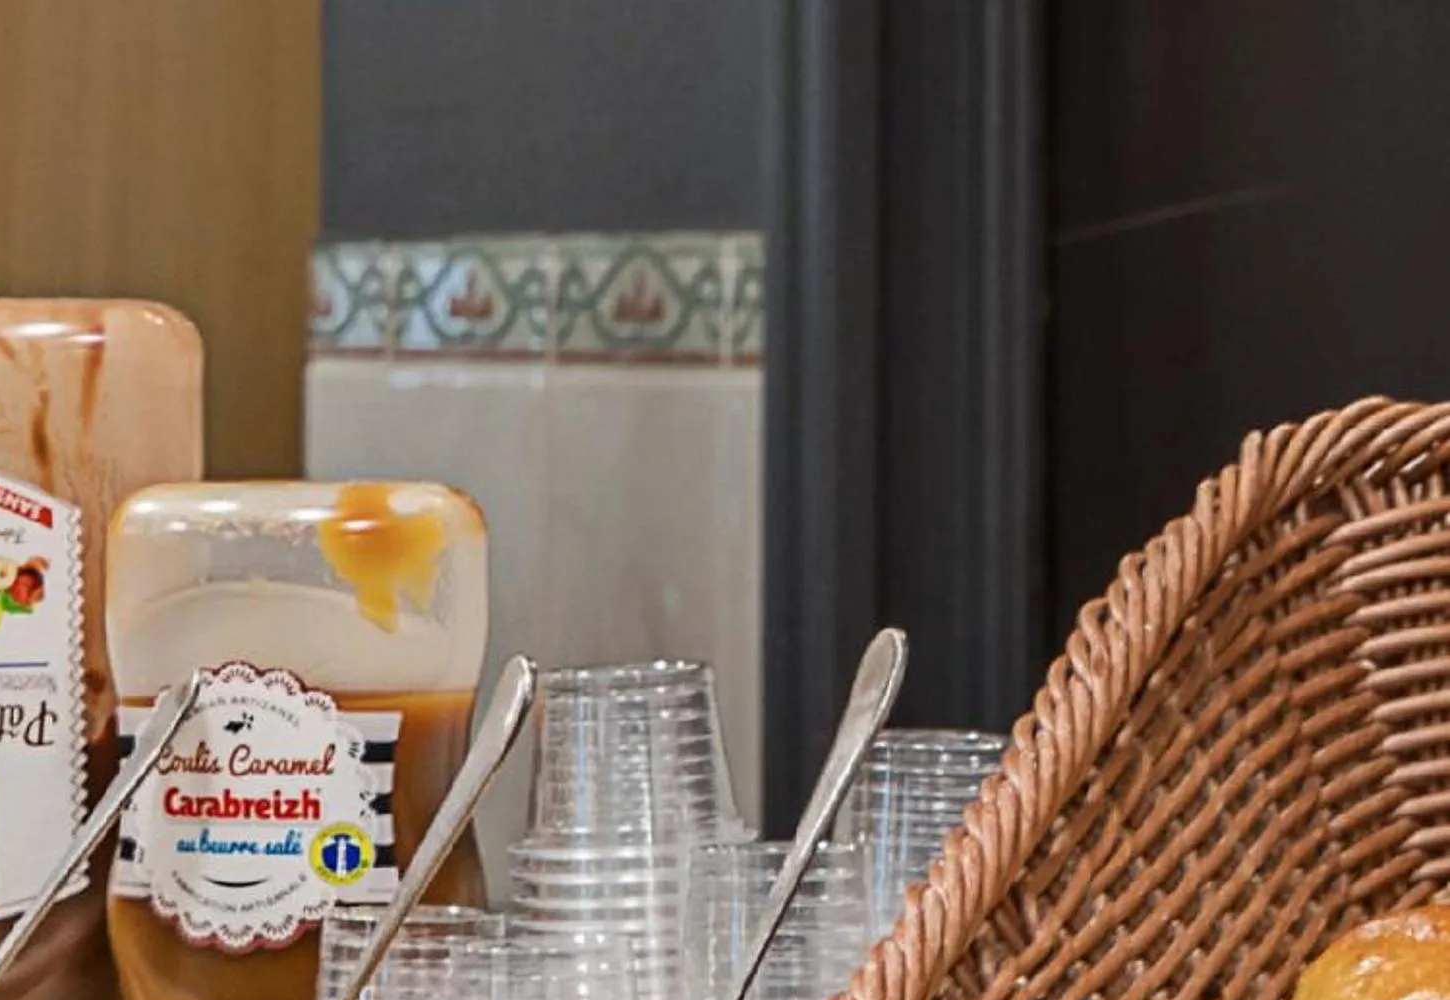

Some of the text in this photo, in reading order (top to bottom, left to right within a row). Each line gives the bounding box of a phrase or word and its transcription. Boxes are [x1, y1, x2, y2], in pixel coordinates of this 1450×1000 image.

[156, 740, 337, 777] Coulis Caramel
[162, 786, 321, 821] Carabreizh
[175, 828, 305, 857] au beurre salé
